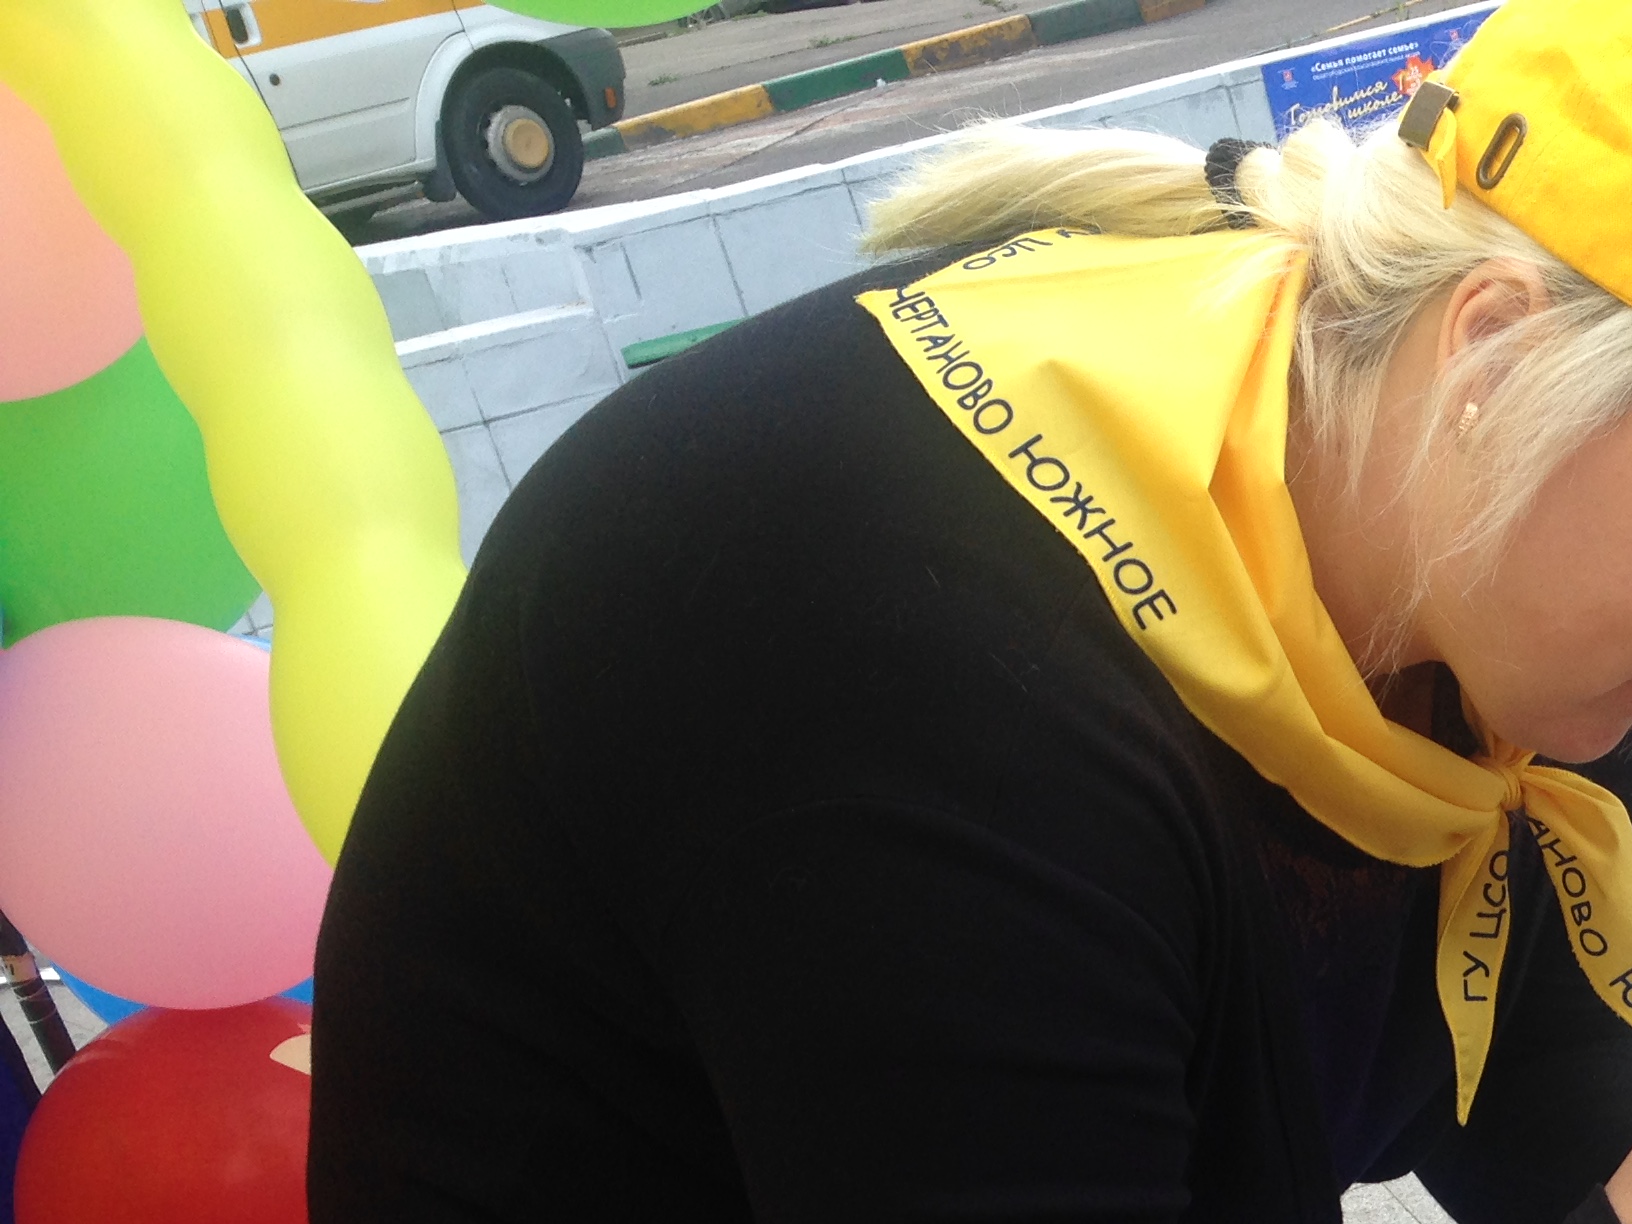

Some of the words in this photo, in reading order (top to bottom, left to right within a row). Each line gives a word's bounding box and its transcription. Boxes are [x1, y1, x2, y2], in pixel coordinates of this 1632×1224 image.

[889, 284, 1014, 435] ЧЕРТАНОВО
[1008, 434, 1178, 630] ЮЖНОЕ
[1469, 850, 1509, 939] ЦСО
[1527, 816, 1609, 957] АНОВО
[1463, 950, 1490, 1002] ГУ
